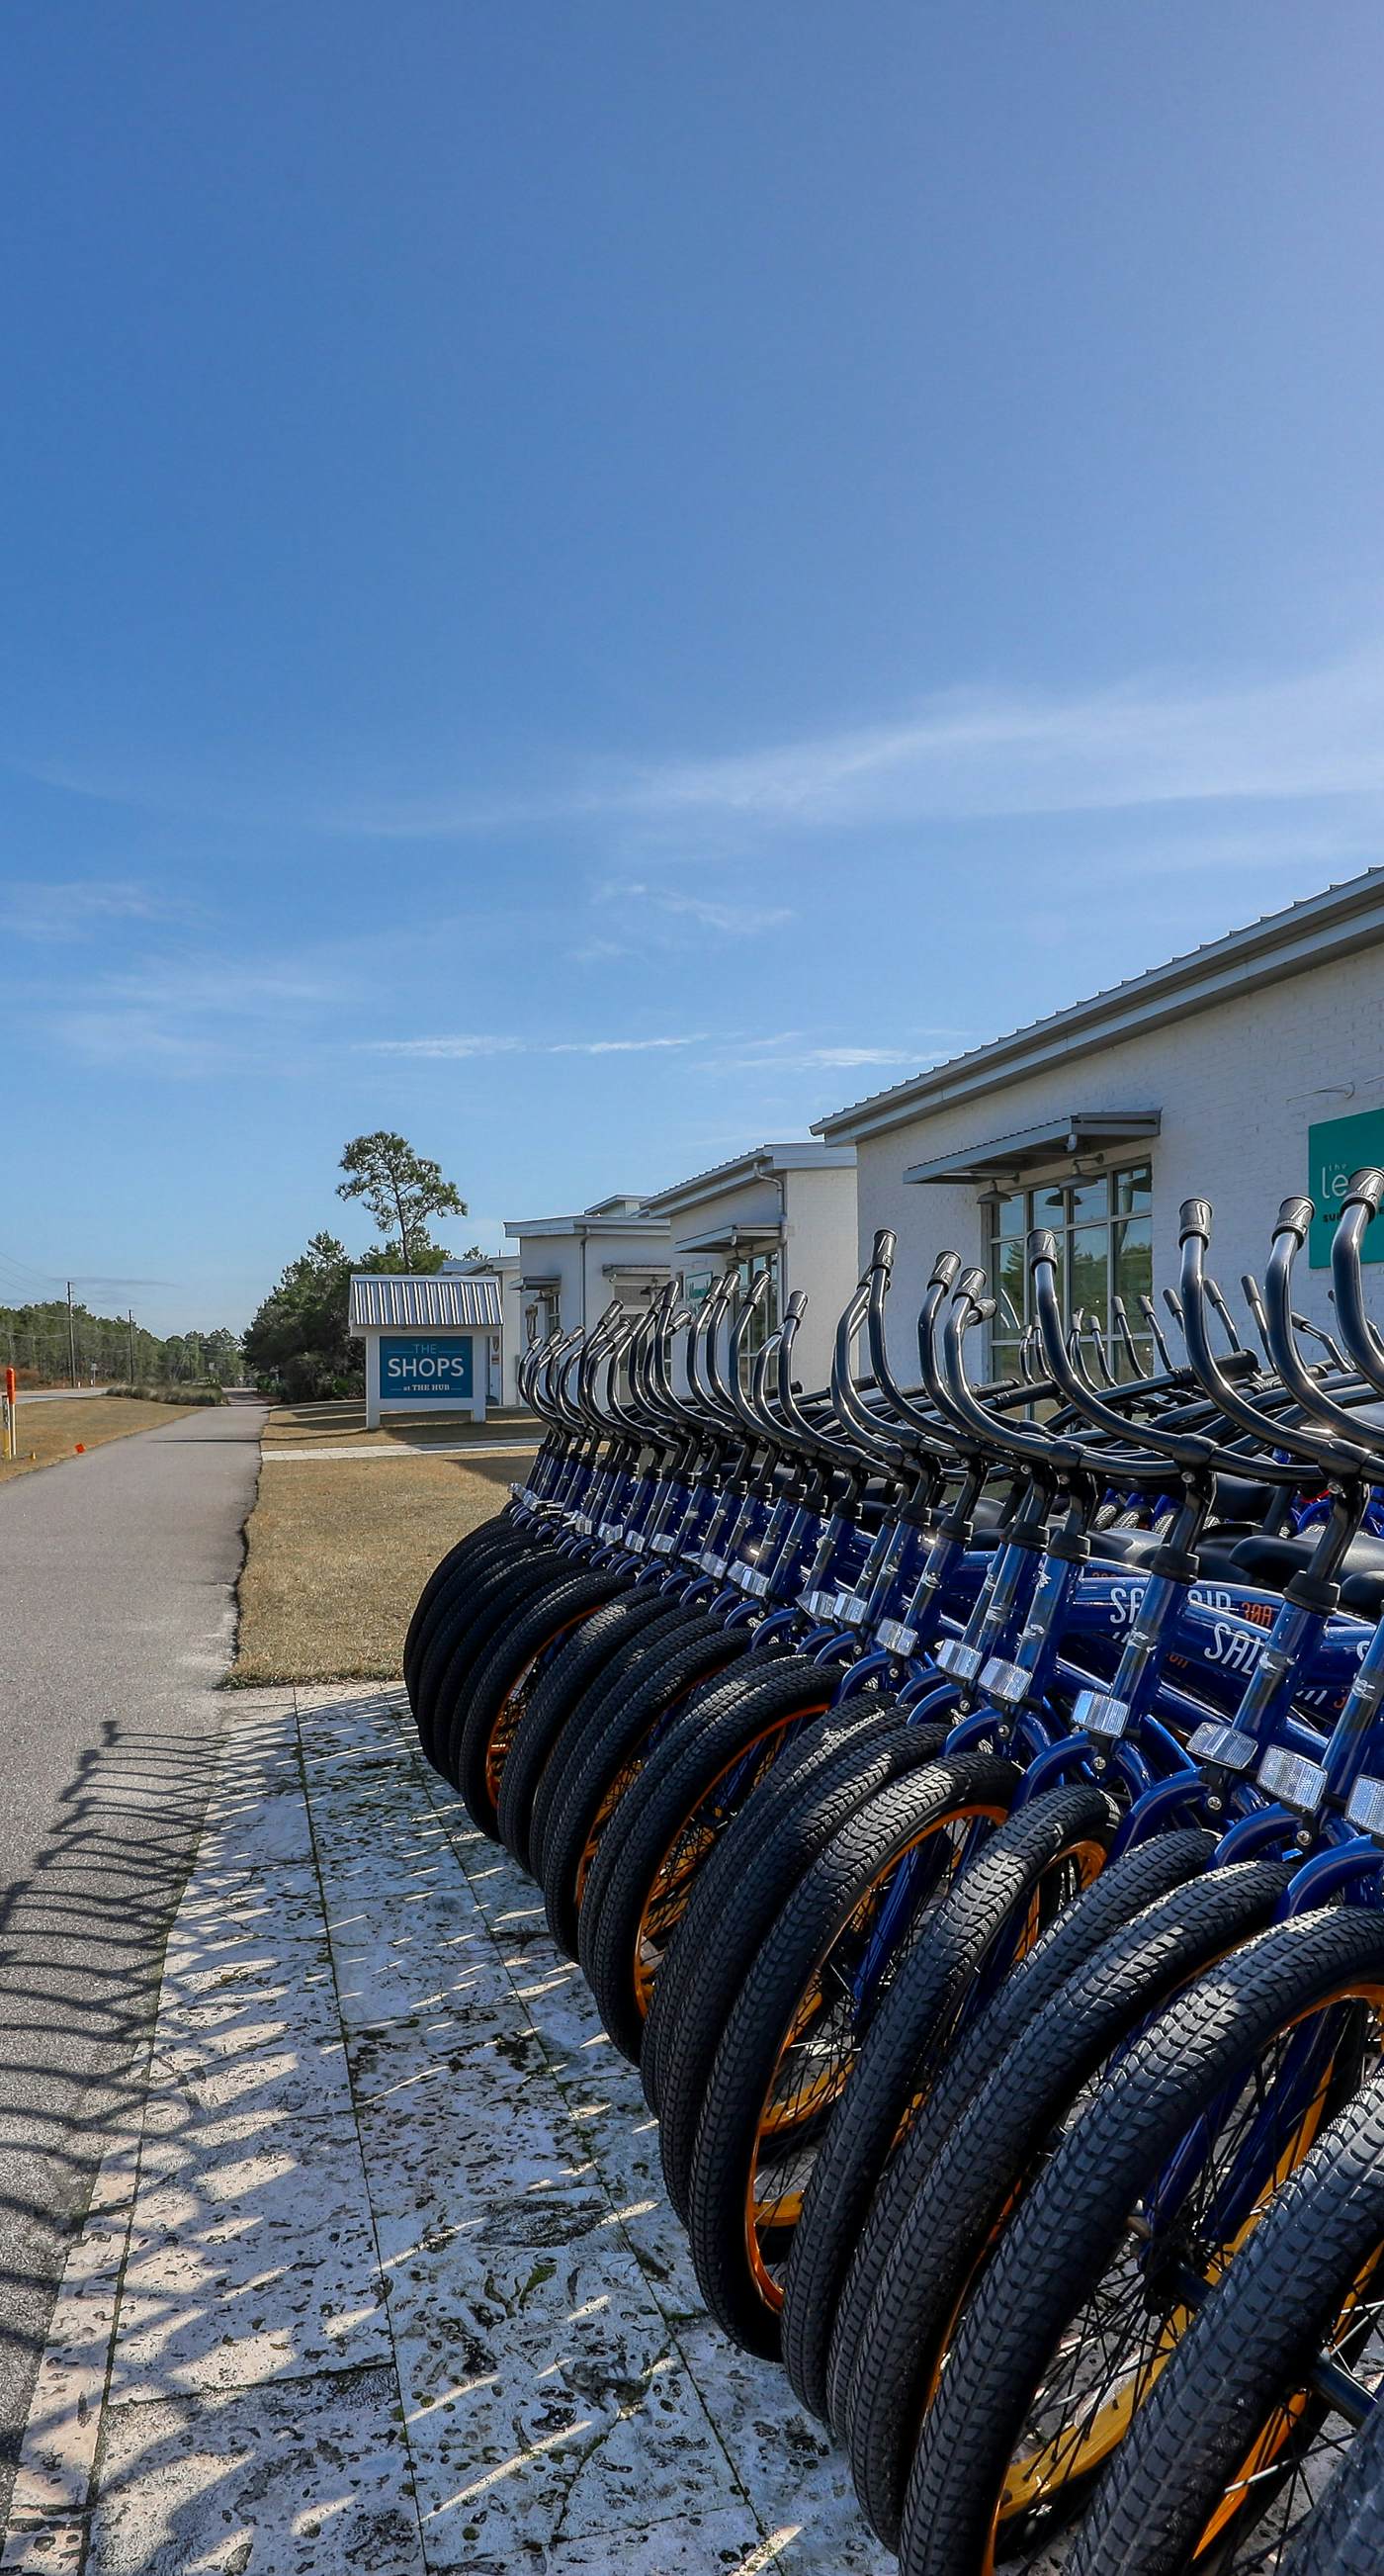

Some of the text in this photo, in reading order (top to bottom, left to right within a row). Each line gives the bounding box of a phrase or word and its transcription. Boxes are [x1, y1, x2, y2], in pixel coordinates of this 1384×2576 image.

[413, 1344, 437, 1354] THE
[388, 1358, 464, 1377] SHOPS
[1203, 1622, 1261, 1675] SAL
